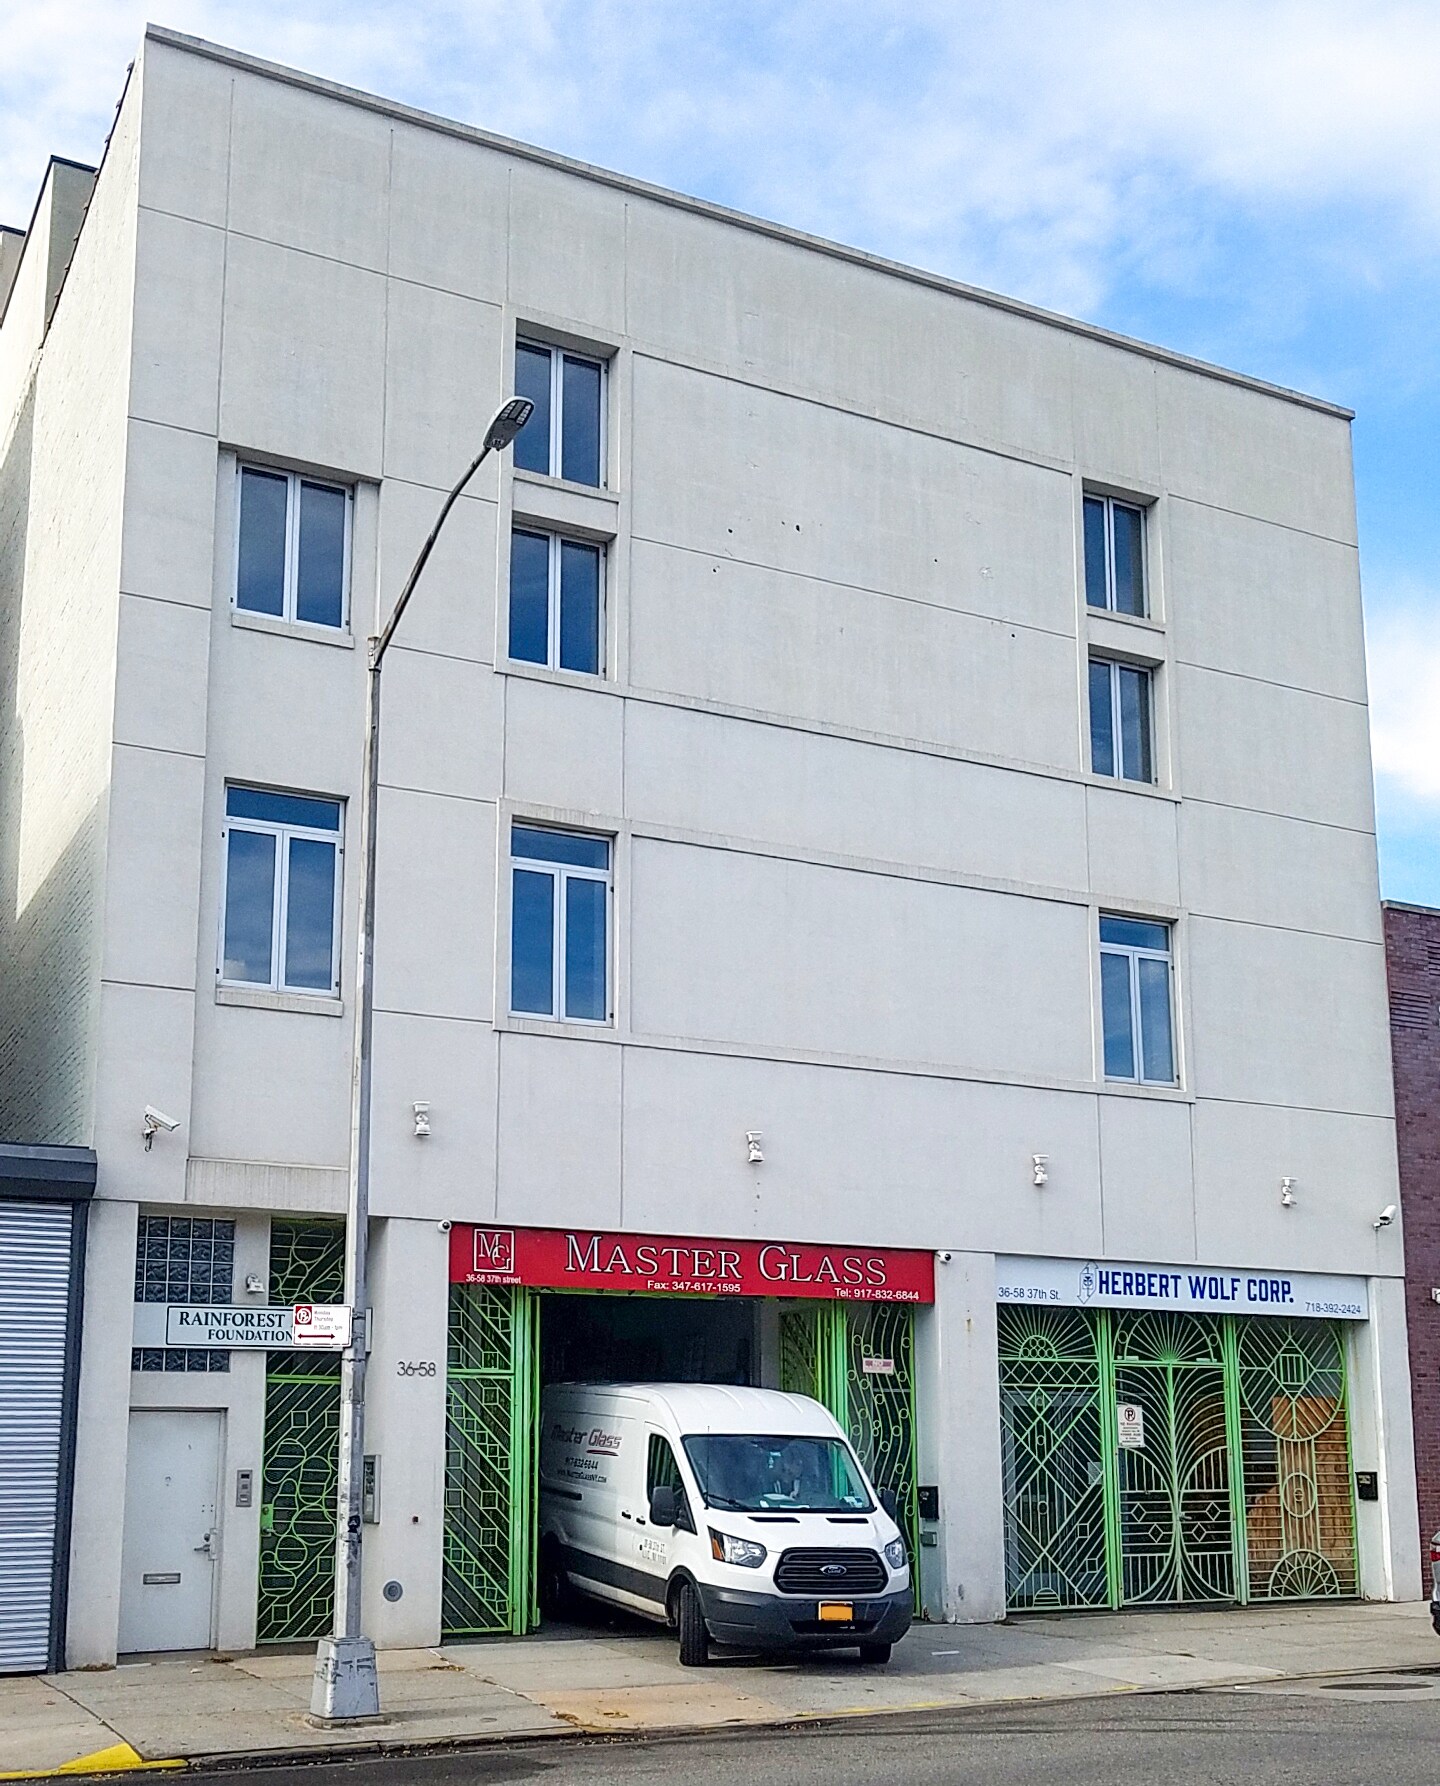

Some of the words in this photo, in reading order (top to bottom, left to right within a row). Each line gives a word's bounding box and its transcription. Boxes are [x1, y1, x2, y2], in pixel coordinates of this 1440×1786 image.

[564, 1234, 743, 1280] MASTER
[759, 1245, 887, 1286] GLASS
[465, 1273, 486, 1283] 36-58
[486, 1274, 502, 1284] 37th
[647, 1280, 669, 1290] Fax:
[672, 1281, 741, 1293] 347-617-1595
[998, 1287, 1025, 1298] 36-58
[1027, 1289, 1047, 1300] 37th
[1049, 1289, 1061, 1300] St.
[1098, 1270, 1182, 1299] HERBERT
[1187, 1275, 1241, 1301] WOLF
[1247, 1278, 1295, 1304] CORP.
[834, 1287, 852, 1298] Tel:
[854, 1288, 920, 1301] 917-832-6844
[1305, 1301, 1362, 1315] 718-392-2424
[178, 1311, 286, 1328] RAINFOREST
[207, 1329, 293, 1342] FOUNDATION
[396, 1361, 436, 1377] 36-58
[588, 1428, 622, 1449] Glass
